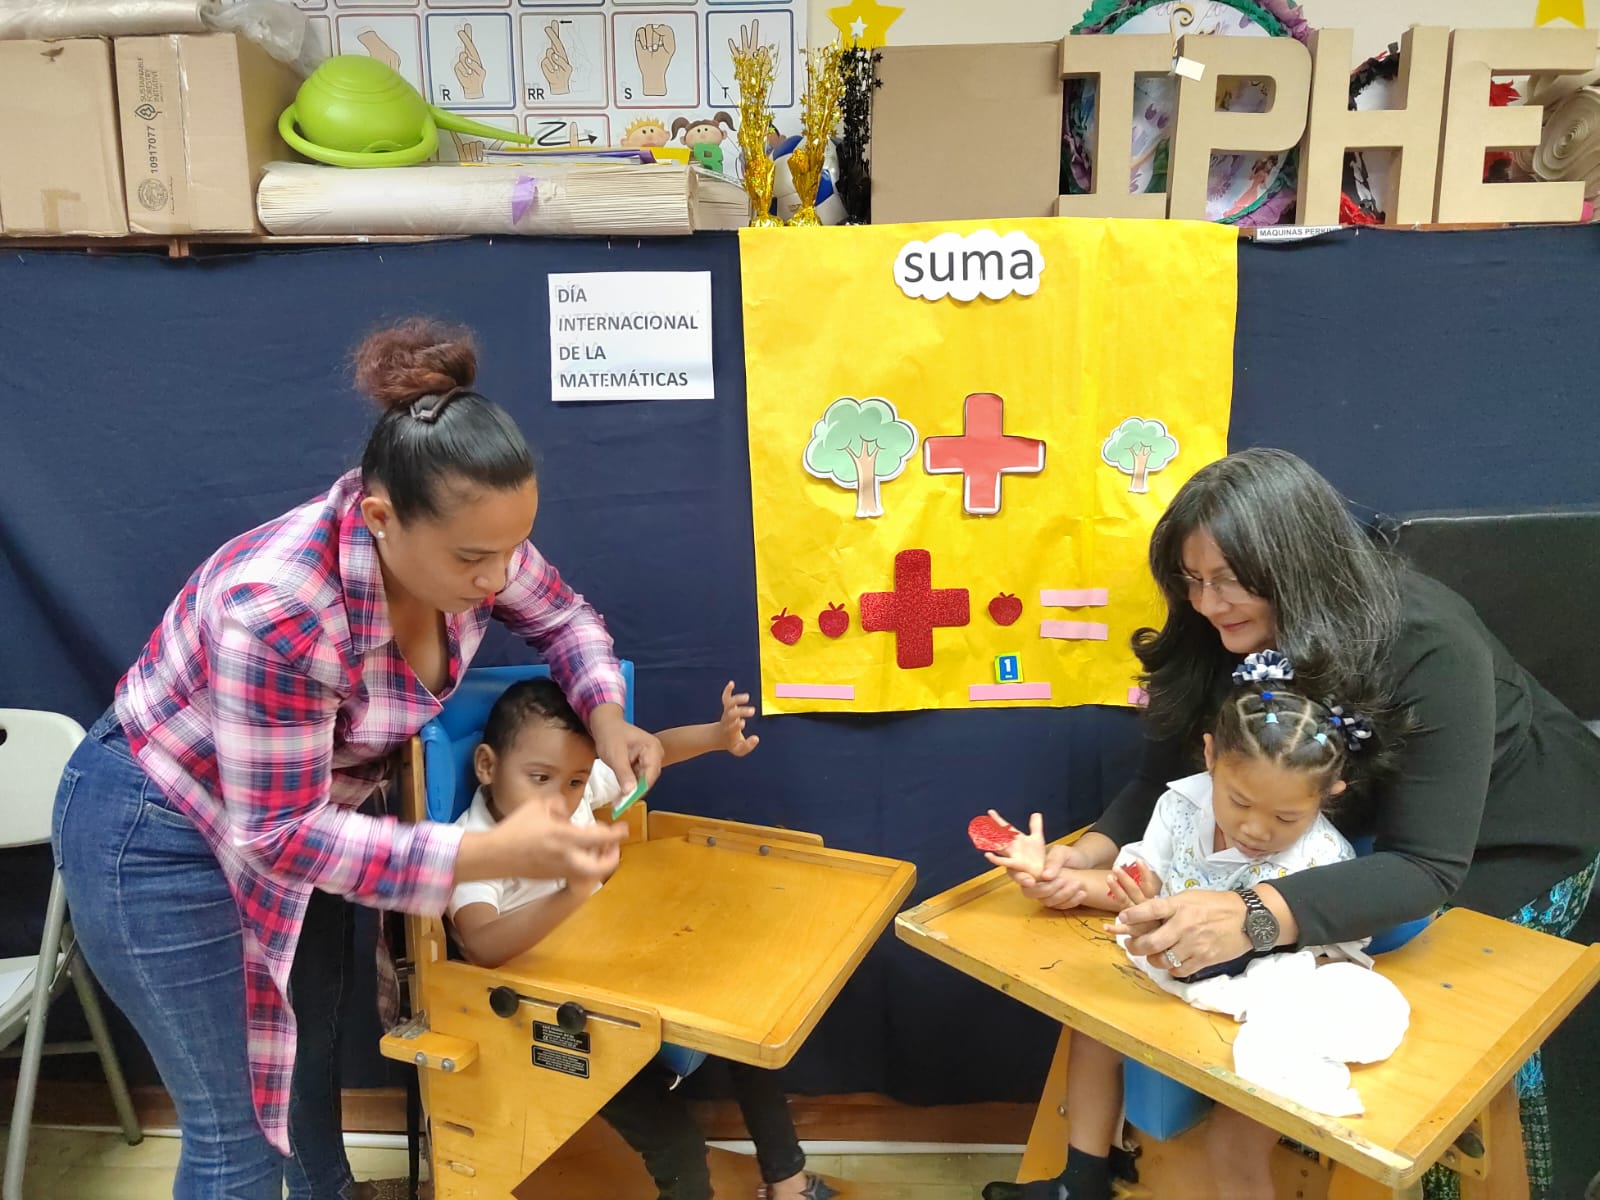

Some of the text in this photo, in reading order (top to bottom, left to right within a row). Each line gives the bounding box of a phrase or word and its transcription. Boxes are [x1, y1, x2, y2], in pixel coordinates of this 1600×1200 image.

[442, 88, 451, 101] R
[527, 88, 545, 100] RR
[624, 87, 632, 100] S
[721, 86, 729, 99] T
[1059, 25, 1598, 225] IPHE
[147, 126, 159, 174] 10917077
[904, 249, 1033, 283] suma
[558, 285, 587, 303] DÍA
[558, 315, 699, 332] INTERNACIONAL
[559, 345, 606, 361] DE LA
[560, 369, 688, 388] MATEMÁTICAS
